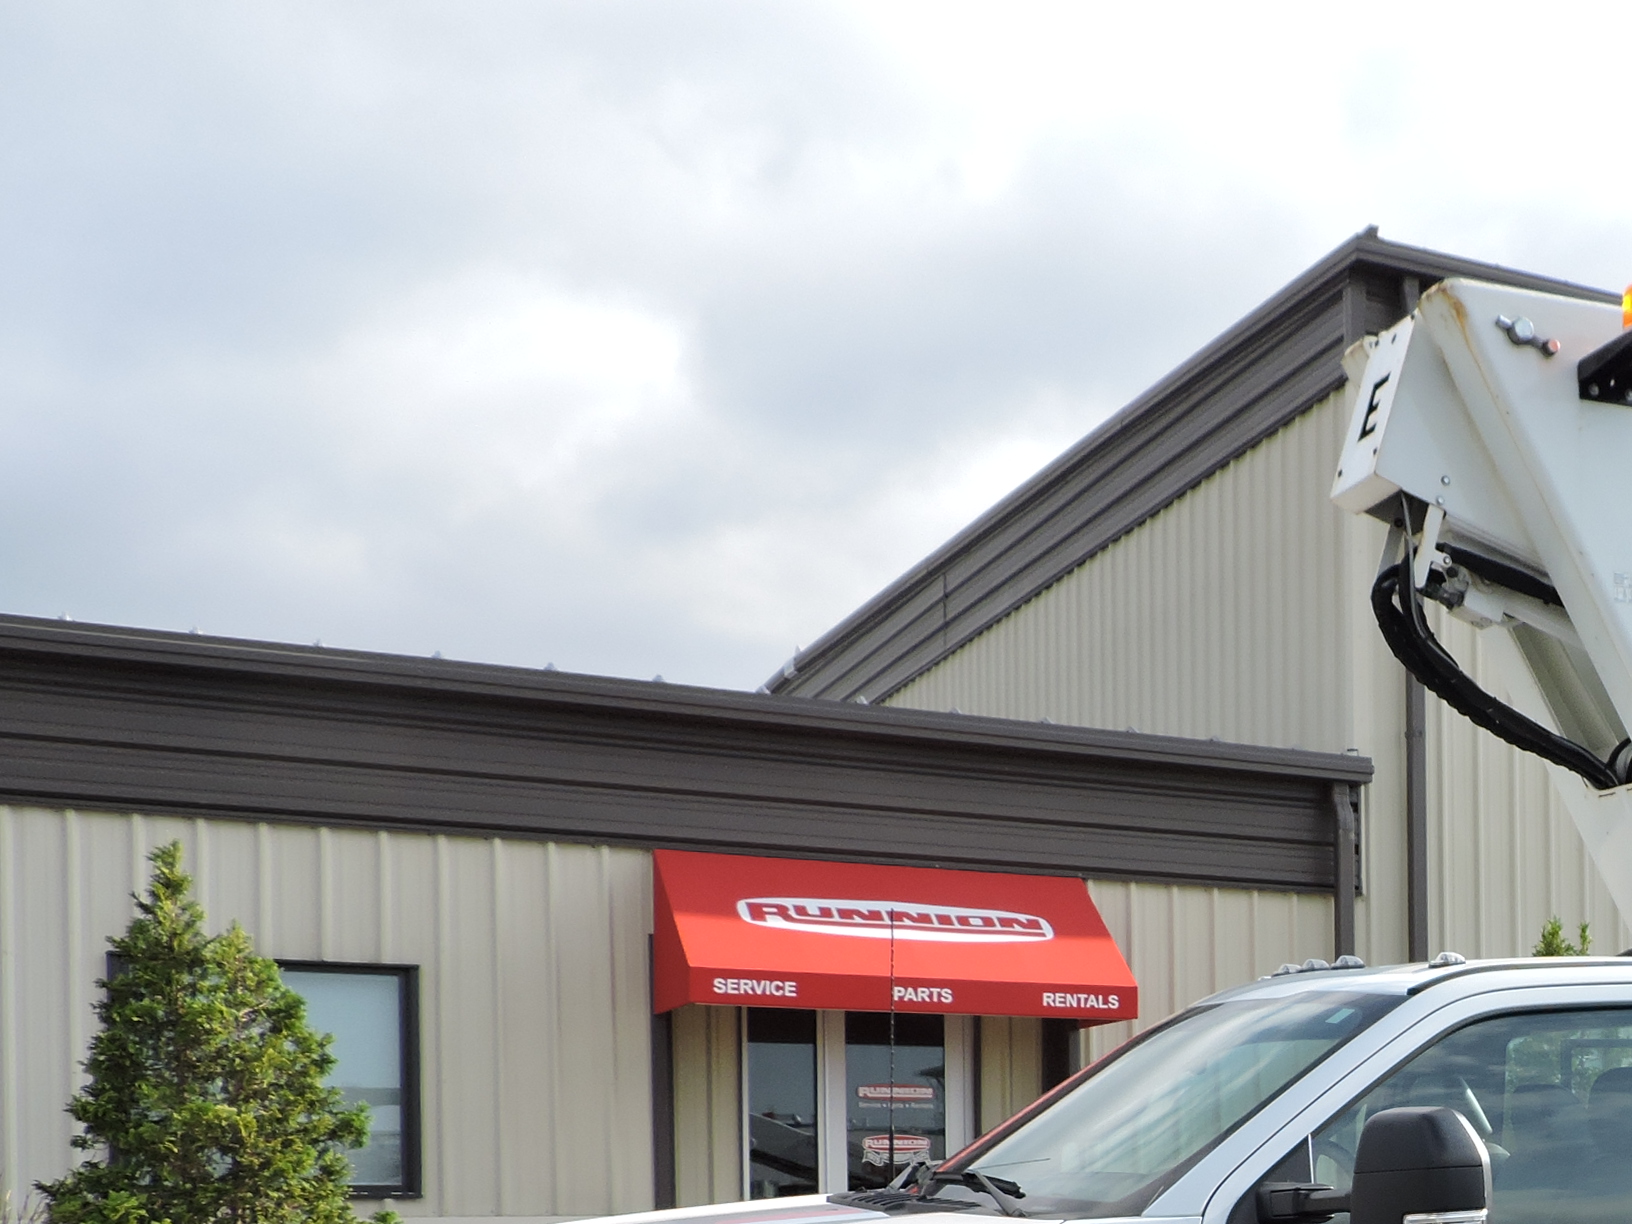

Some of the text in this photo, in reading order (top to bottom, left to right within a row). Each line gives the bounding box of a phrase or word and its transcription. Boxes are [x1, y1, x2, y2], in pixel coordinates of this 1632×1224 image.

[744, 902, 1047, 938] RUNNION
[713, 977, 798, 997] SERVICE
[893, 986, 953, 1004] PARTS
[1042, 992, 1119, 1009] RENTALS
[858, 1086, 934, 1099] RUNNION
